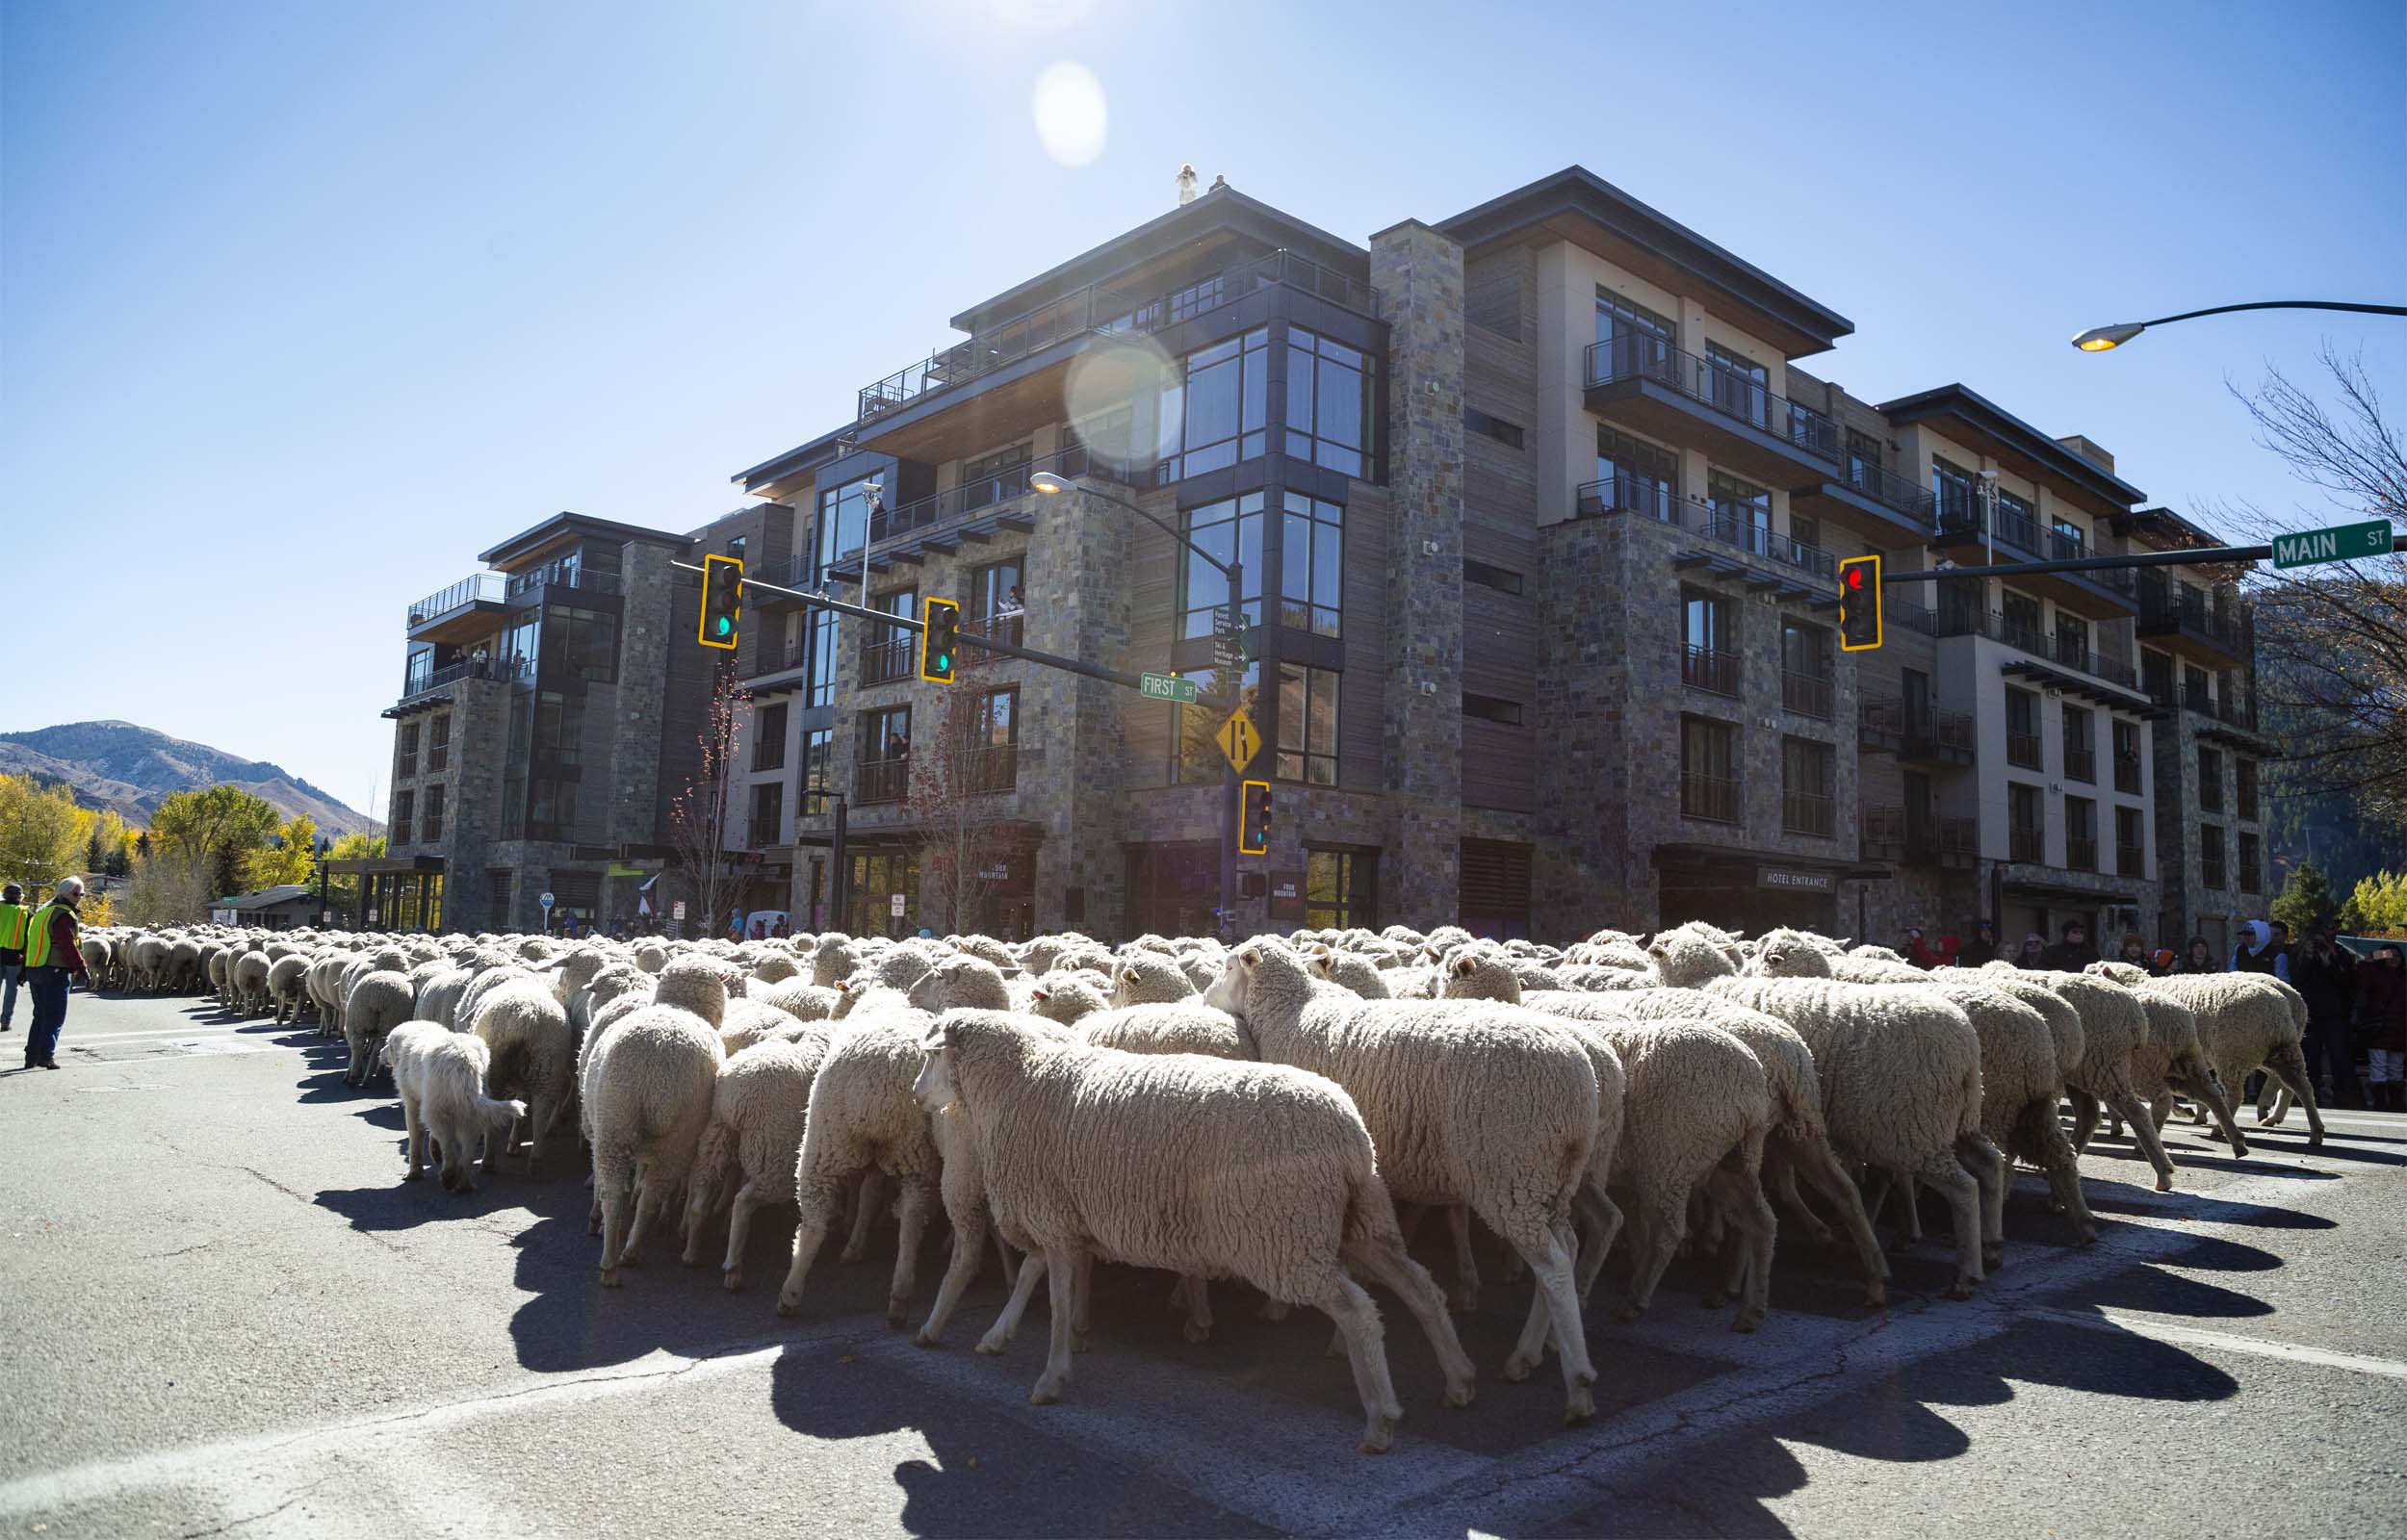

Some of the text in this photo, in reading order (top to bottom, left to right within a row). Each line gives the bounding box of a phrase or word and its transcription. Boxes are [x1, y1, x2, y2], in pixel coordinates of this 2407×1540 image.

[2279, 529, 2385, 563] MAIN ST
[1144, 676, 1194, 697] FIRST ST
[1767, 873, 1827, 888] HOTEL ENTRANCE
